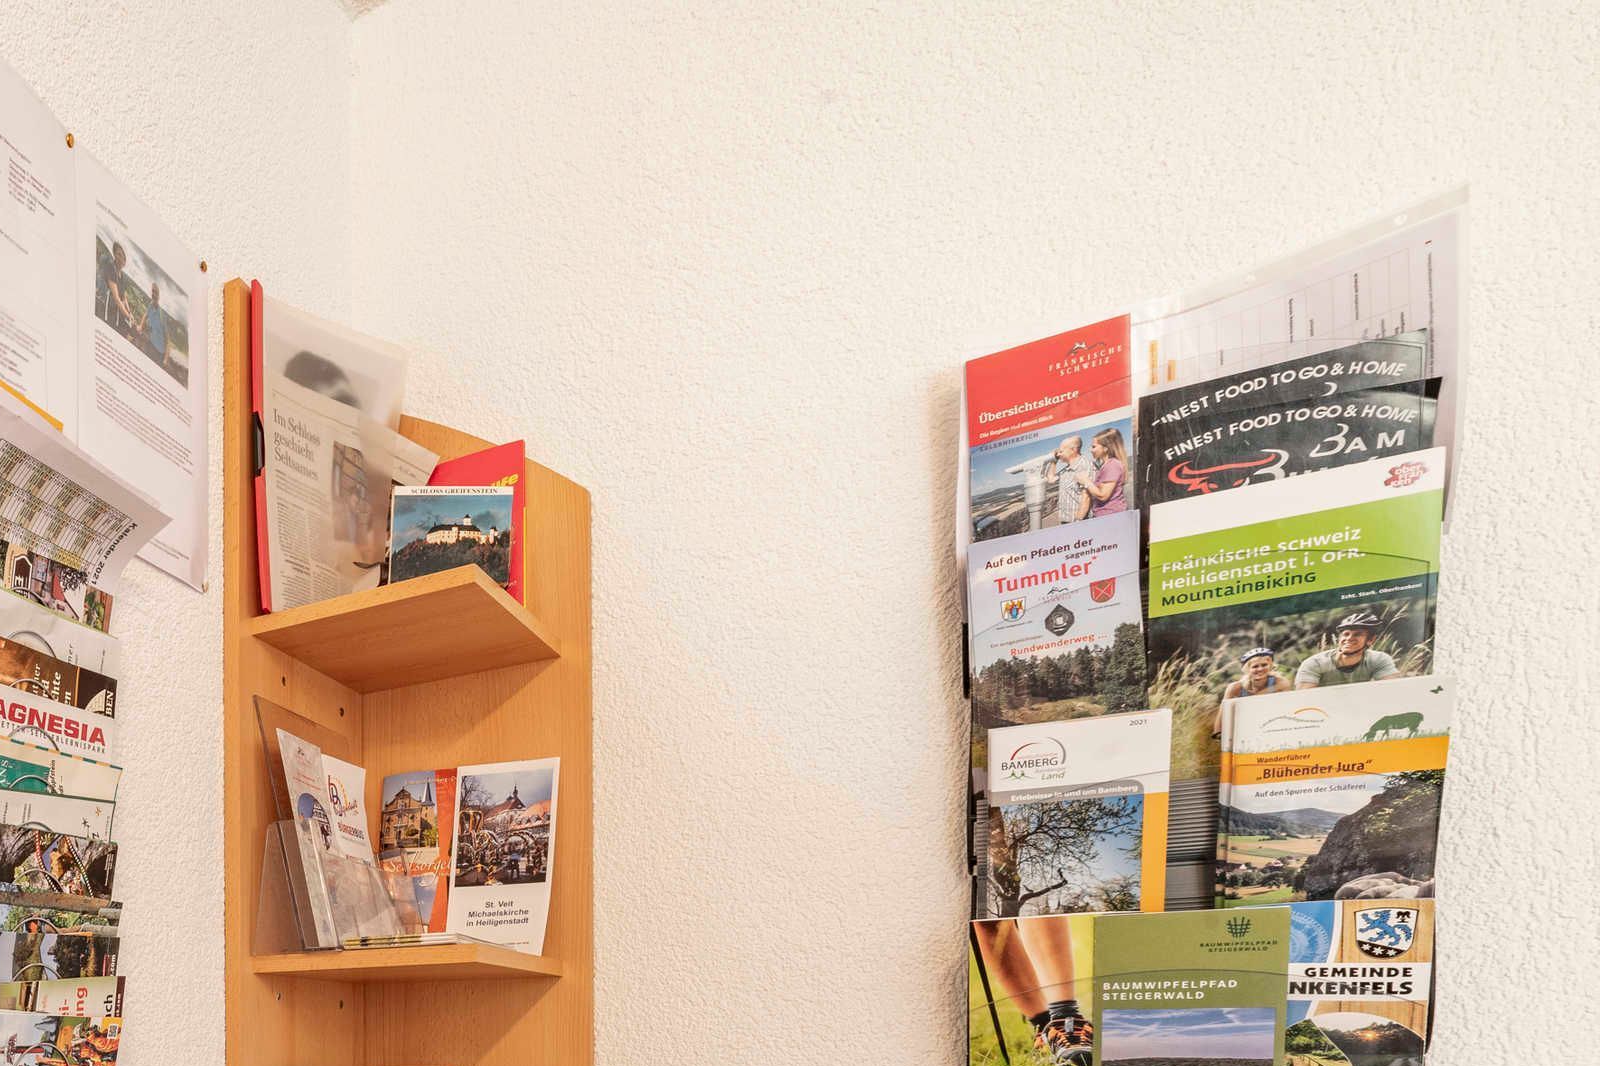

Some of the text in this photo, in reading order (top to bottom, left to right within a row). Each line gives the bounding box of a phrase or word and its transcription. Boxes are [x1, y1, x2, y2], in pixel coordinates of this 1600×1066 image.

[1049, 344, 1124, 374] FRÄNKISCHE
[1059, 356, 1111, 377] SCHWEIZ
[978, 389, 1079, 424] Übersichtskarte
[1164, 403, 1419, 461] FINEST FOOD TO GO & HOME
[90, 522, 138, 585] Kalender 2021
[984, 538, 1093, 570] Auf den Pfaden der
[1065, 543, 1118, 560] sagenhaften
[1303, 551, 1315, 567] i.
[1129, 719, 1147, 727] 2021
[1001, 757, 1058, 771] BAMBERG
[1256, 753, 1311, 764] Wanderführer
[468, 909, 529, 918] Michaelskirche
[476, 918, 529, 927] Heiligenstadt
[1305, 967, 1413, 979] GEMEINDE
[1103, 979, 1238, 991] BAUMWIPFELPFAD
[1103, 991, 1205, 1001] STEIGERWALD
